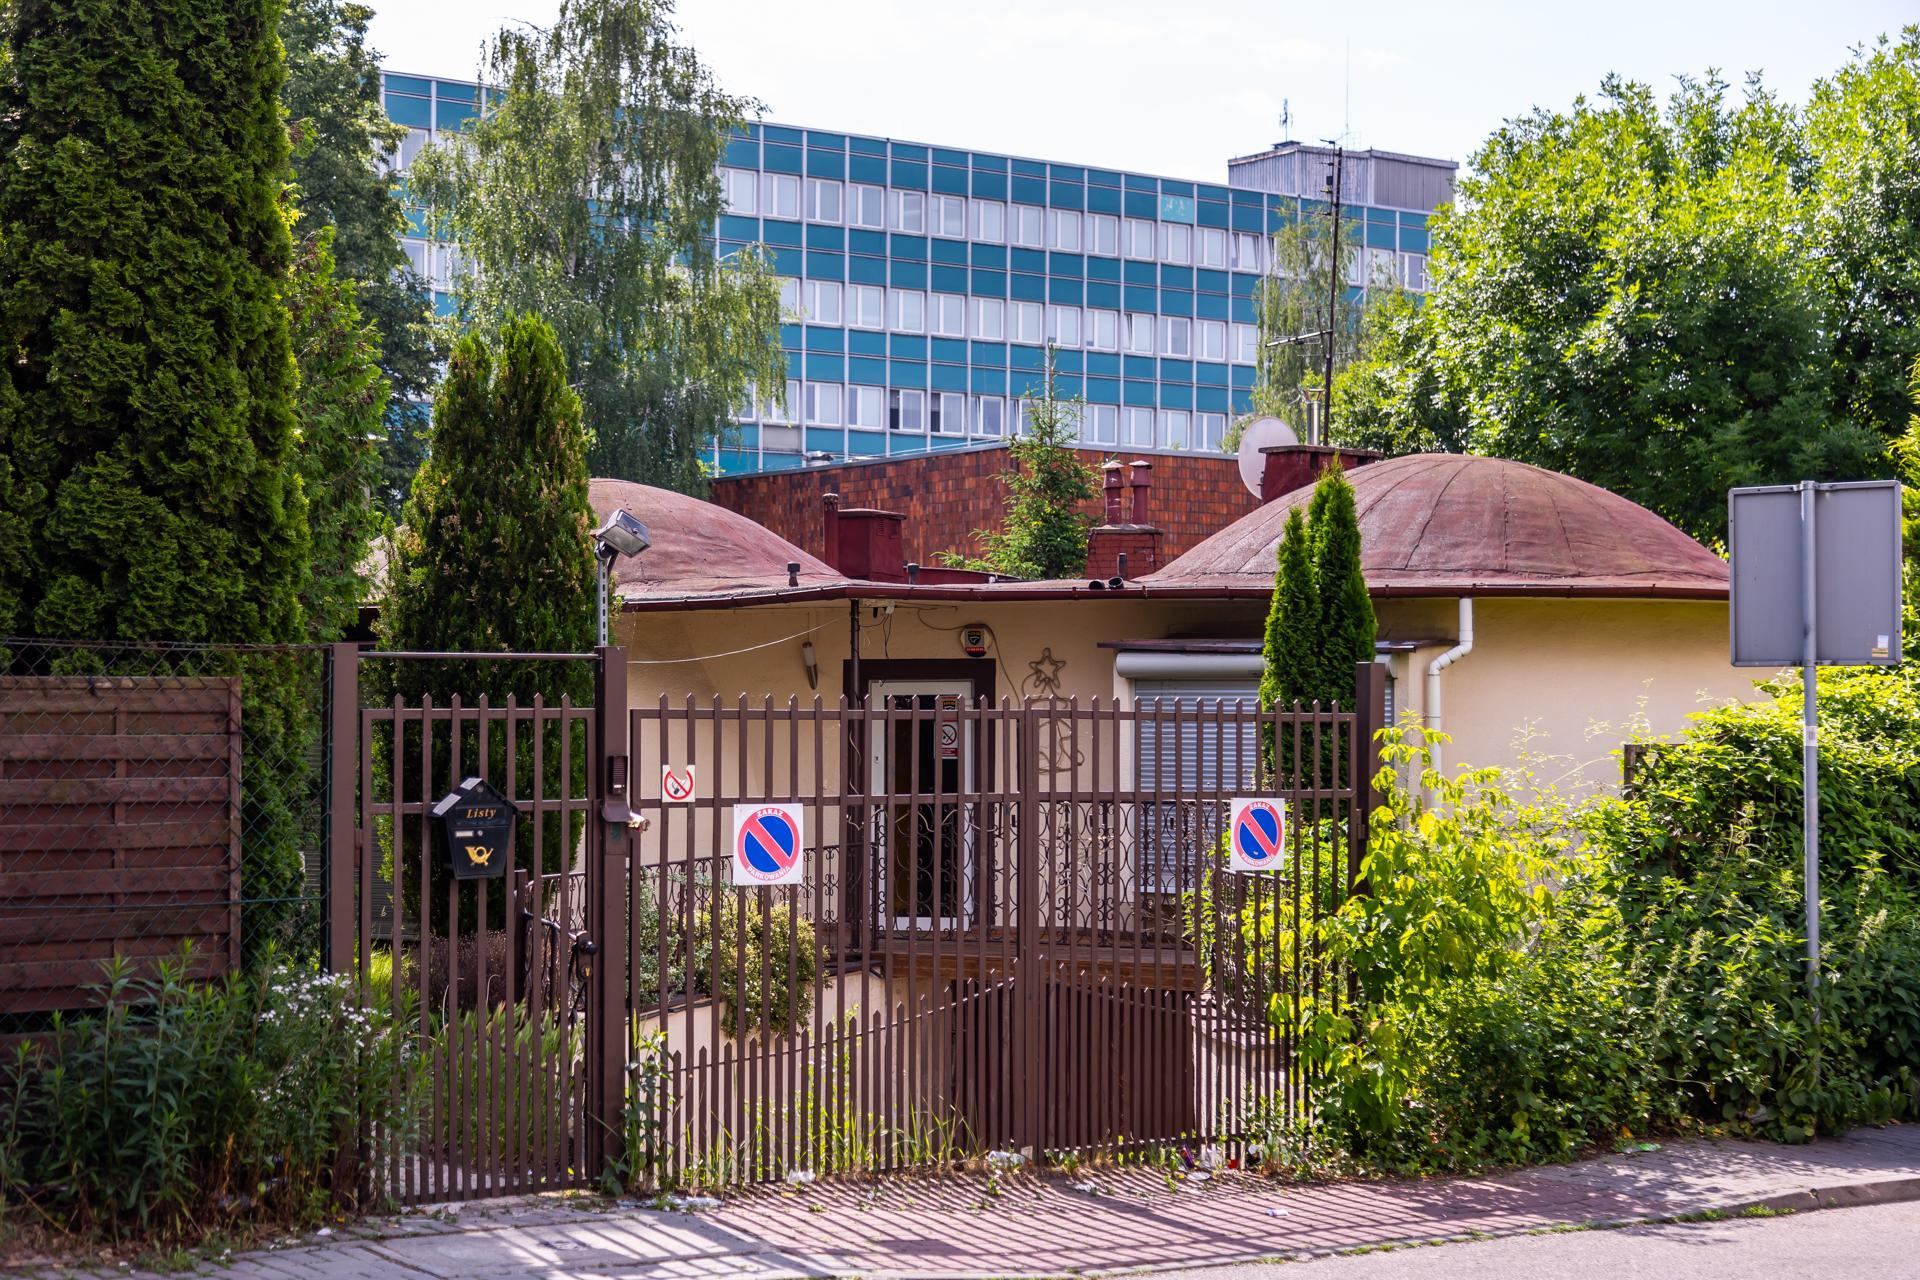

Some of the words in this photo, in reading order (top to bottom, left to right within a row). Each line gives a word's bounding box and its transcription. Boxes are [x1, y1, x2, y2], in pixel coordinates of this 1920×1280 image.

[1249, 802, 1270, 810] ZAKAZ
[466, 808, 497, 819] Listy
[757, 808, 784, 818] ZAKAZ
